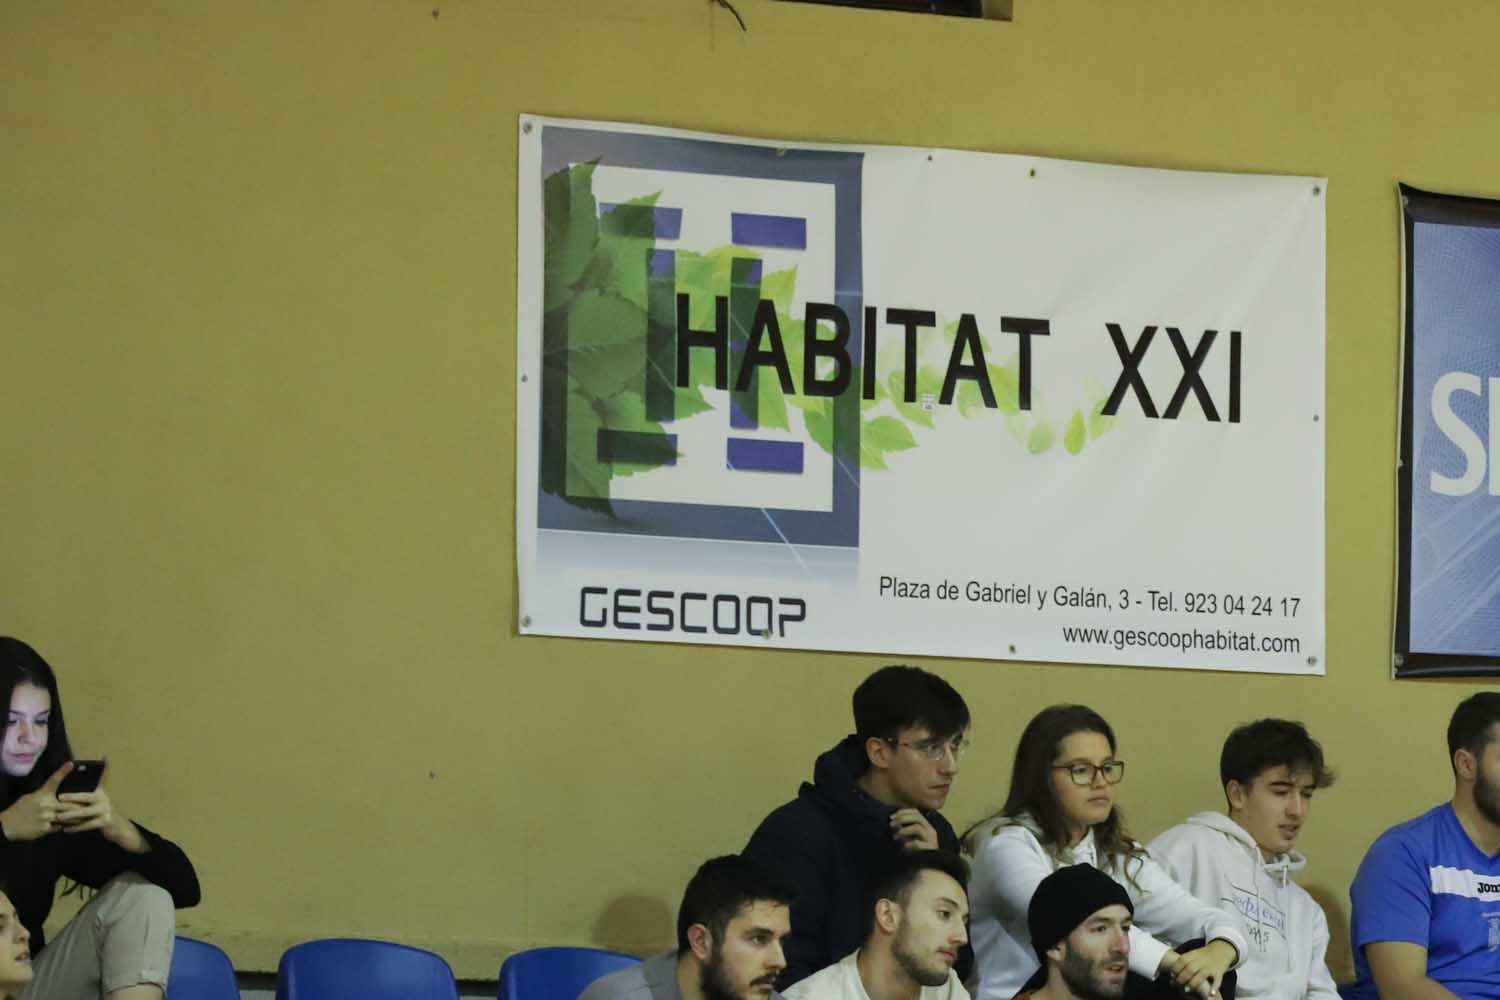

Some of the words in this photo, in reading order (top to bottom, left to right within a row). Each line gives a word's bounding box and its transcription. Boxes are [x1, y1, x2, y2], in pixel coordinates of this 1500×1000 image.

[676, 293, 1049, 410] HABITAT
[1101, 322, 1241, 423] XXI
[580, 586, 806, 637] GESCOOP
[879, 576, 930, 599] Plaza
[937, 579, 960, 600] de
[966, 580, 1031, 604] Gabriel
[1037, 589, 1047, 610] y
[1053, 585, 1112, 611] Galán,
[1119, 589, 1130, 609] 3
[1147, 590, 1178, 612] Tel.
[1184, 592, 1217, 614] 923
[1223, 594, 1245, 615] 04
[1251, 595, 1273, 616] 24
[1280, 597, 1300, 617] 17
[1063, 625, 1300, 653] www.gescoophabitat.com
